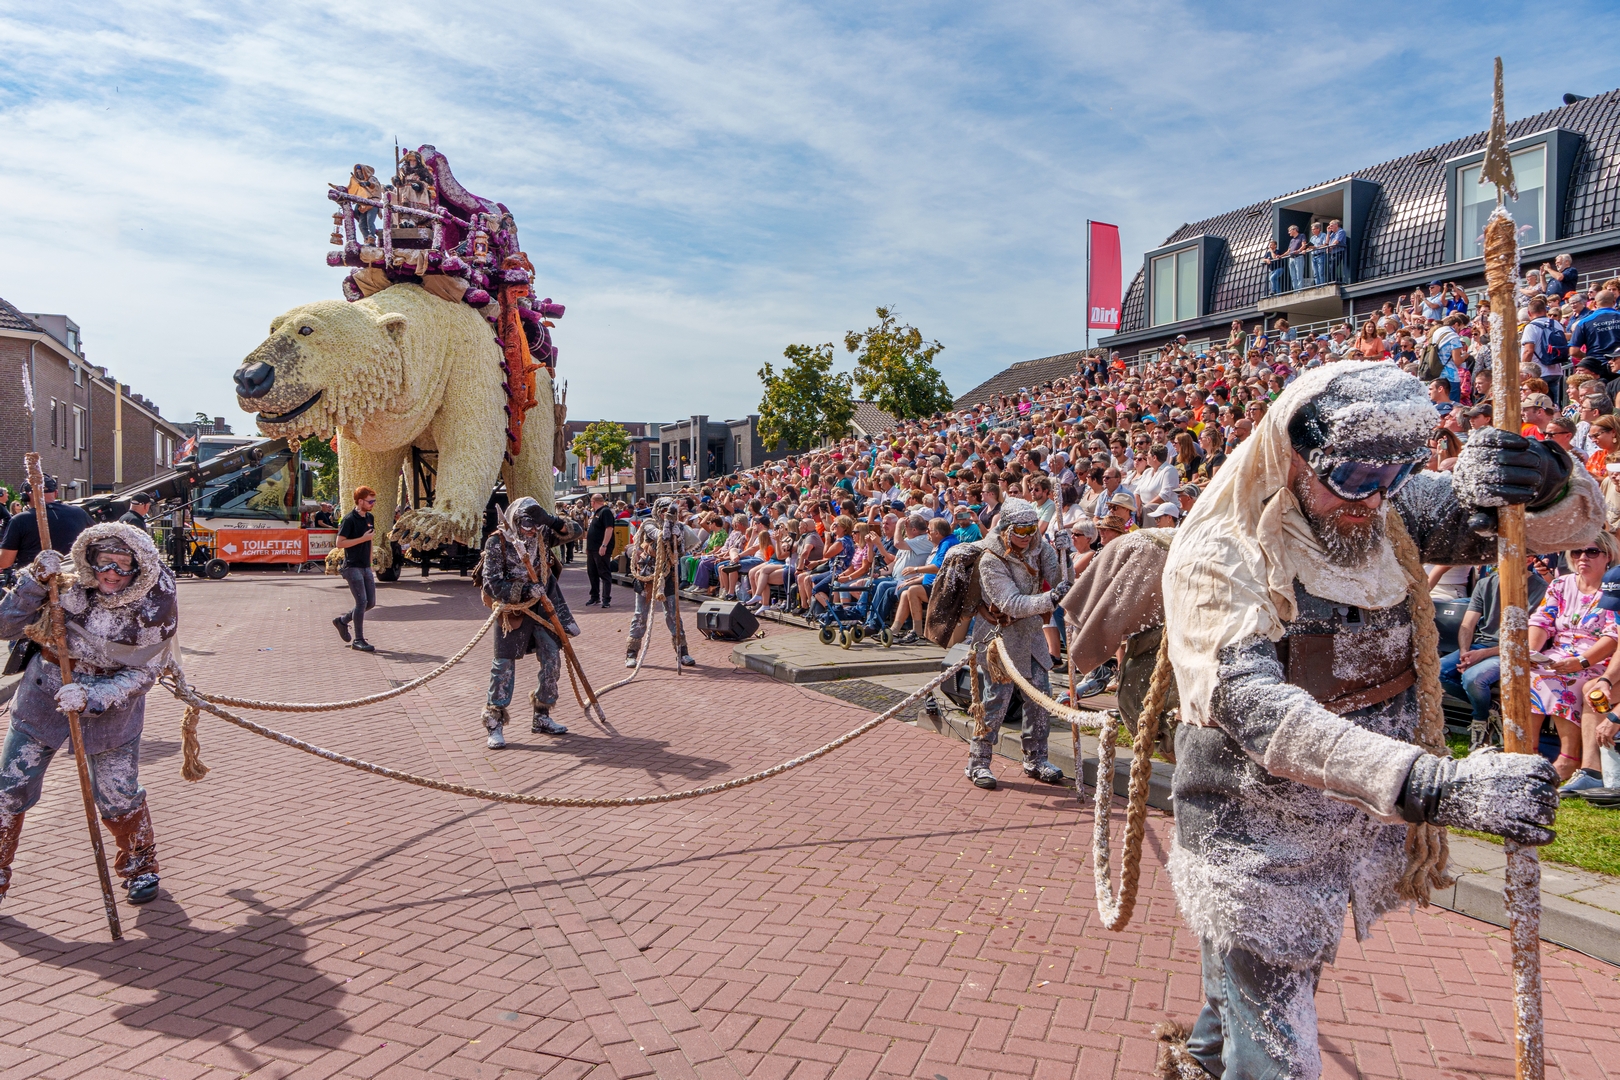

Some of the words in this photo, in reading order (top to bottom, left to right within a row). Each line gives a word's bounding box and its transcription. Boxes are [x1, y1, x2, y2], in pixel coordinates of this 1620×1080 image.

[1091, 307, 1118, 323] Dirk
[1593, 319, 1620, 327] Scorpio
[1597, 324, 1620, 332] Securit
[242, 540, 302, 550] TOILETTEN
